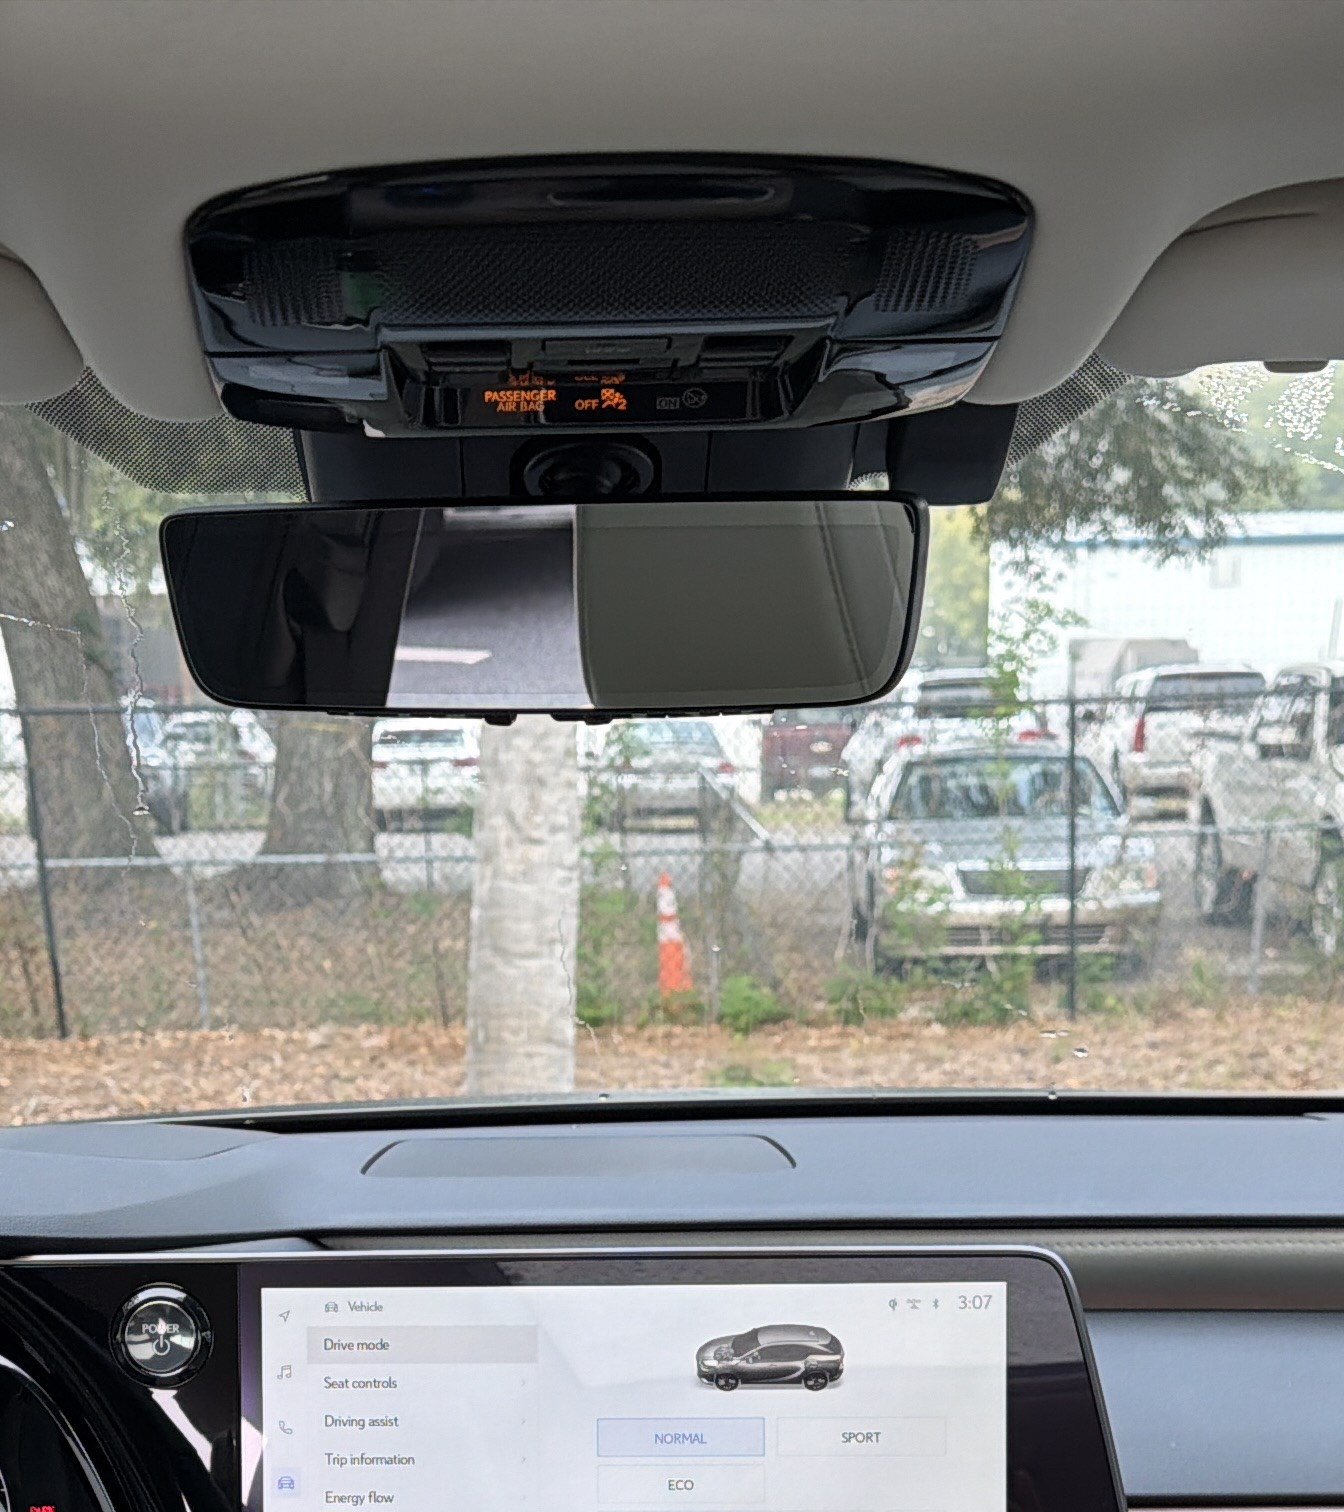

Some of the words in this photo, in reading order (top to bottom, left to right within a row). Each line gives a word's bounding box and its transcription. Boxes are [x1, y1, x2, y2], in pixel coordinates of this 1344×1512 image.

[484, 389, 557, 402] PASSENGER
[496, 400, 517, 412] AIR
[520, 400, 545, 412] BAG
[574, 399, 599, 411] OFF
[347, 1300, 384, 1312] Vehicle
[958, 1295, 992, 1309] 3:07
[324, 1338, 354, 1351] Drive
[357, 1338, 390, 1351] mode
[324, 1376, 349, 1389] Seat
[352, 1376, 397, 1389] controls
[325, 1414, 365, 1430] Driving
[368, 1416, 399, 1427] assist
[654, 1433, 706, 1445] NORMAL
[841, 1432, 881, 1444] SPORT
[325, 1453, 348, 1468] Trip
[350, 1452, 415, 1465] information
[668, 1479, 694, 1491] ECO
[325, 1491, 365, 1506] Energy
[368, 1490, 394, 1503] flow
